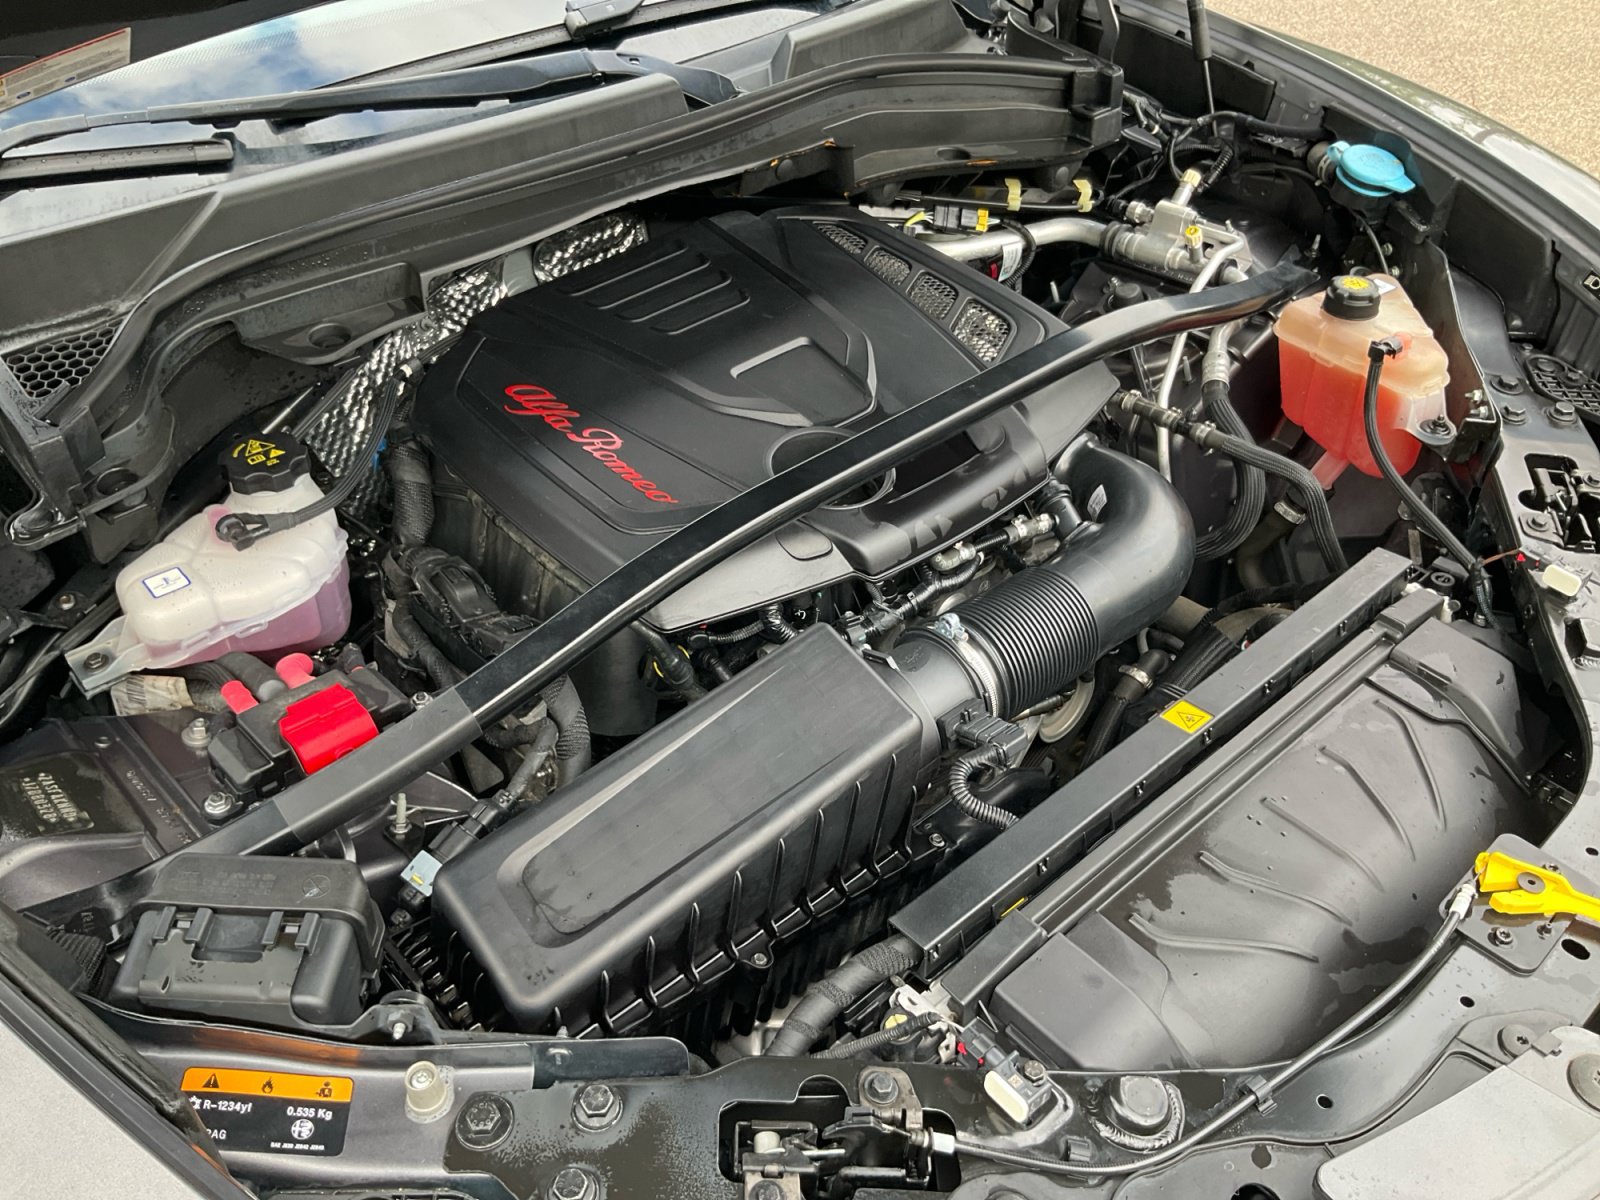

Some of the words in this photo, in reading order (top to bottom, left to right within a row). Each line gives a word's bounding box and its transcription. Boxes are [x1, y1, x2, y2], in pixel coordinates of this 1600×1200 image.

[504, 384, 581, 433] Alfa
[566, 427, 679, 504] Romeo
[286, 1106, 316, 1118] 0.535
[317, 1108, 333, 1121] Kg
